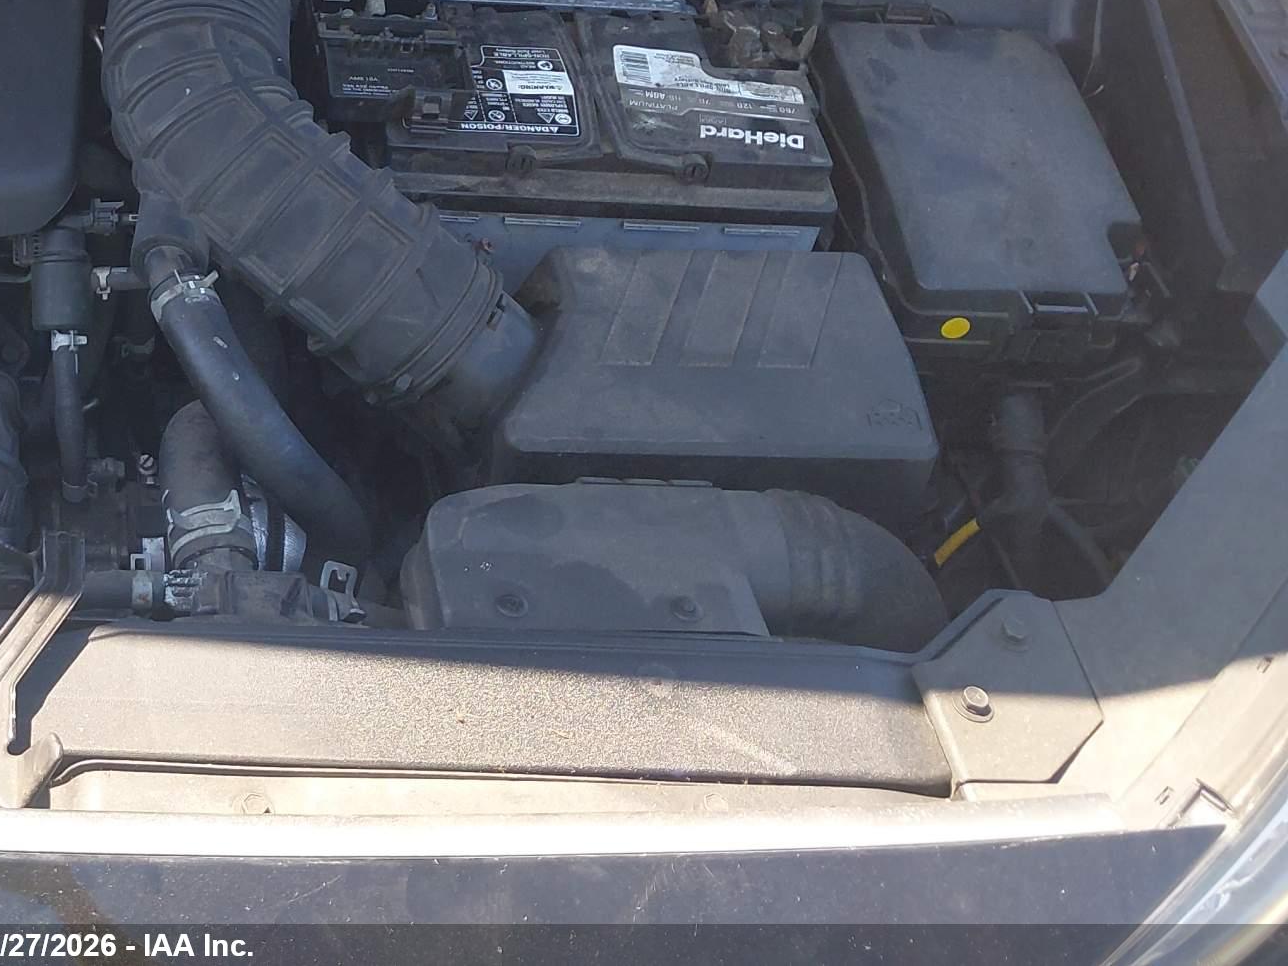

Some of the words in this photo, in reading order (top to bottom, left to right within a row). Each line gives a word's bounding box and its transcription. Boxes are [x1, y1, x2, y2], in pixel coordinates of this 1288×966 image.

[629, 99, 678, 111] PLATINUM
[461, 123, 551, 133] DANGER/POISON
[699, 124, 805, 150] DieHard
